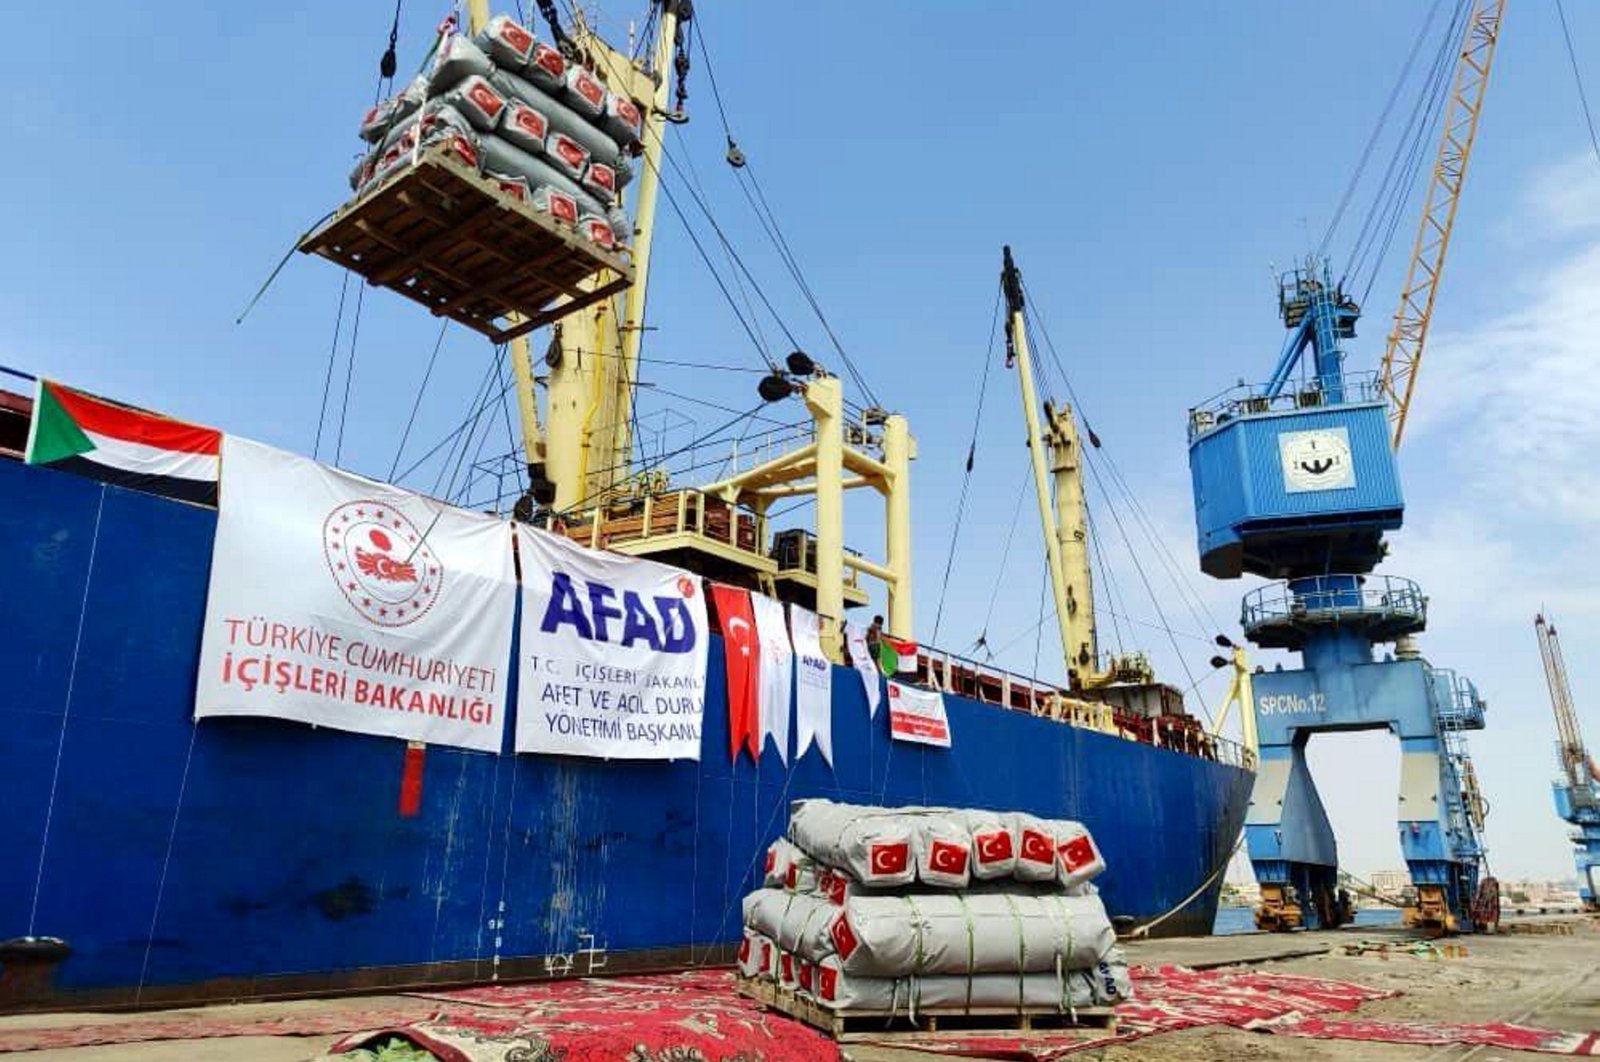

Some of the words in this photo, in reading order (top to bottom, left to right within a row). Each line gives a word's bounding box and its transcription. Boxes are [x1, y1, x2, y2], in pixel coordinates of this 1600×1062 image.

[540, 571, 696, 654] AFAD
[221, 652, 347, 701] İÇİŞLERİ
[354, 680, 493, 724] BAKANLIĞI
[224, 615, 341, 661] TÜRKİYE
[345, 641, 496, 693] CUMHURİYETİ
[541, 683, 583, 706] AFET
[590, 690, 611, 709] VE
[545, 709, 622, 739] YÖNETİMİ
